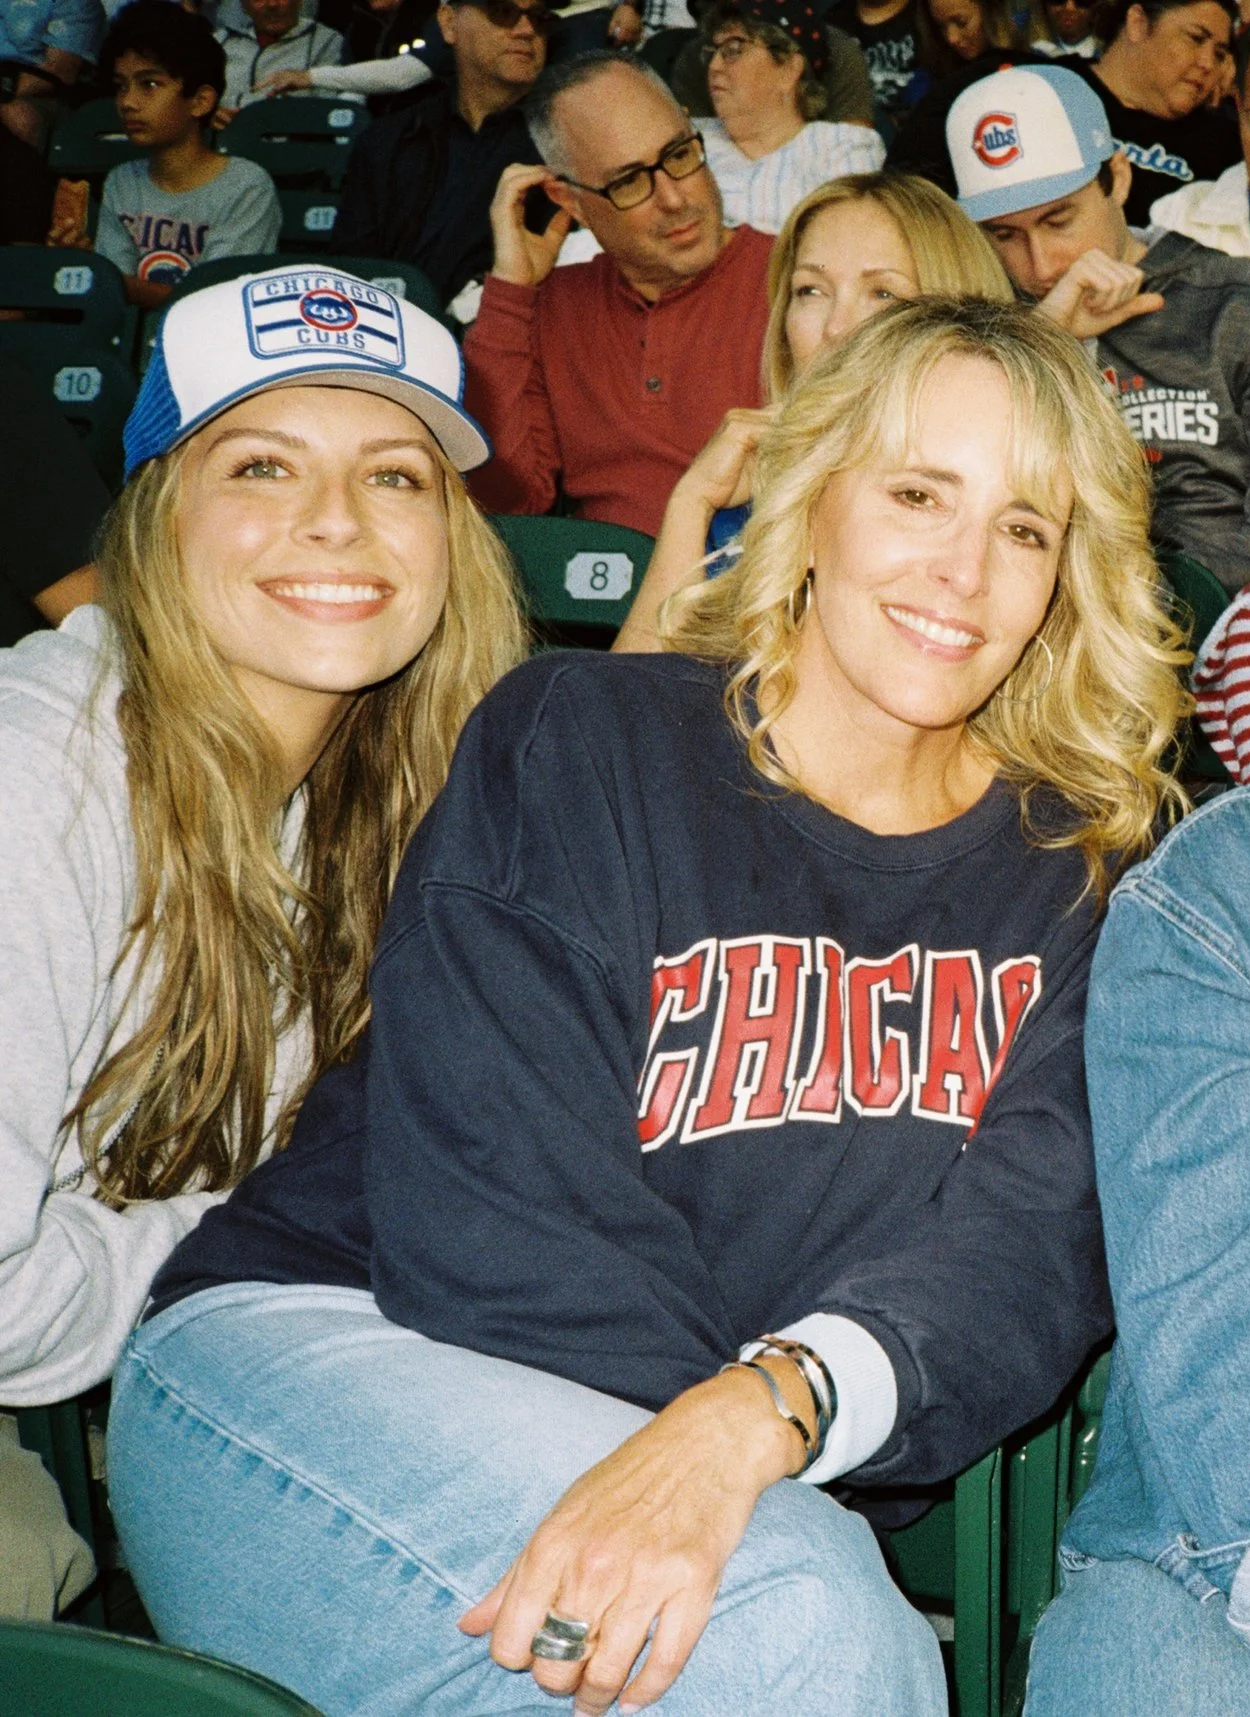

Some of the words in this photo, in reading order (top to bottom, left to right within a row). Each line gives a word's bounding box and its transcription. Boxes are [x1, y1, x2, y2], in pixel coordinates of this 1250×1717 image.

[64, 271, 83, 289] 11
[265, 278, 378, 304] CHICAGO
[297, 328, 366, 349] CUBS
[64, 372, 92, 395] 10
[1115, 387, 1208, 407] OLLECTION
[1122, 400, 1219, 446] ERIES
[590, 561, 609, 591] 8
